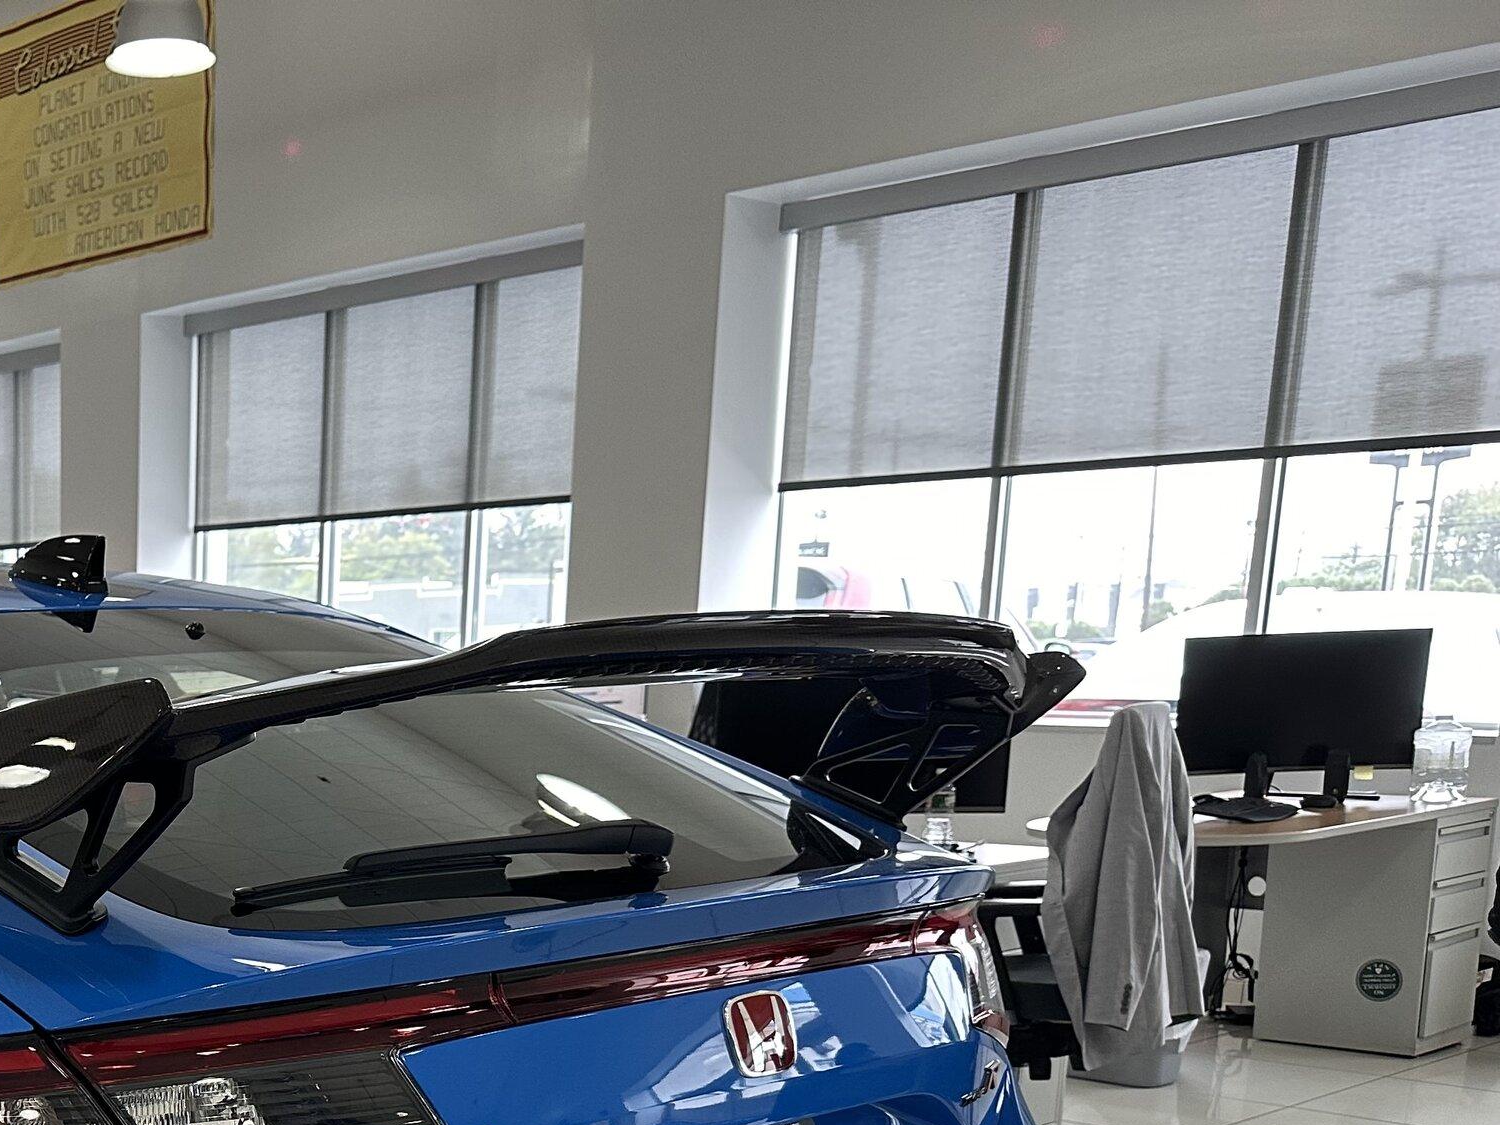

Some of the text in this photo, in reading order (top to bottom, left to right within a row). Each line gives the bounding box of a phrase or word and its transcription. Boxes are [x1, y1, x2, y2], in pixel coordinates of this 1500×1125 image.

[14, 21, 100, 95] Colossal
[34, 89, 154, 147] CONGRATULATIONS
[40, 81, 85, 116] PLANET
[24, 119, 166, 181] ON SETTING A NEW
[25, 149, 169, 209] JUNE SALES RECORD
[33, 209, 66, 238] WITH
[74, 204, 201, 255] AMERICAN HONDA
